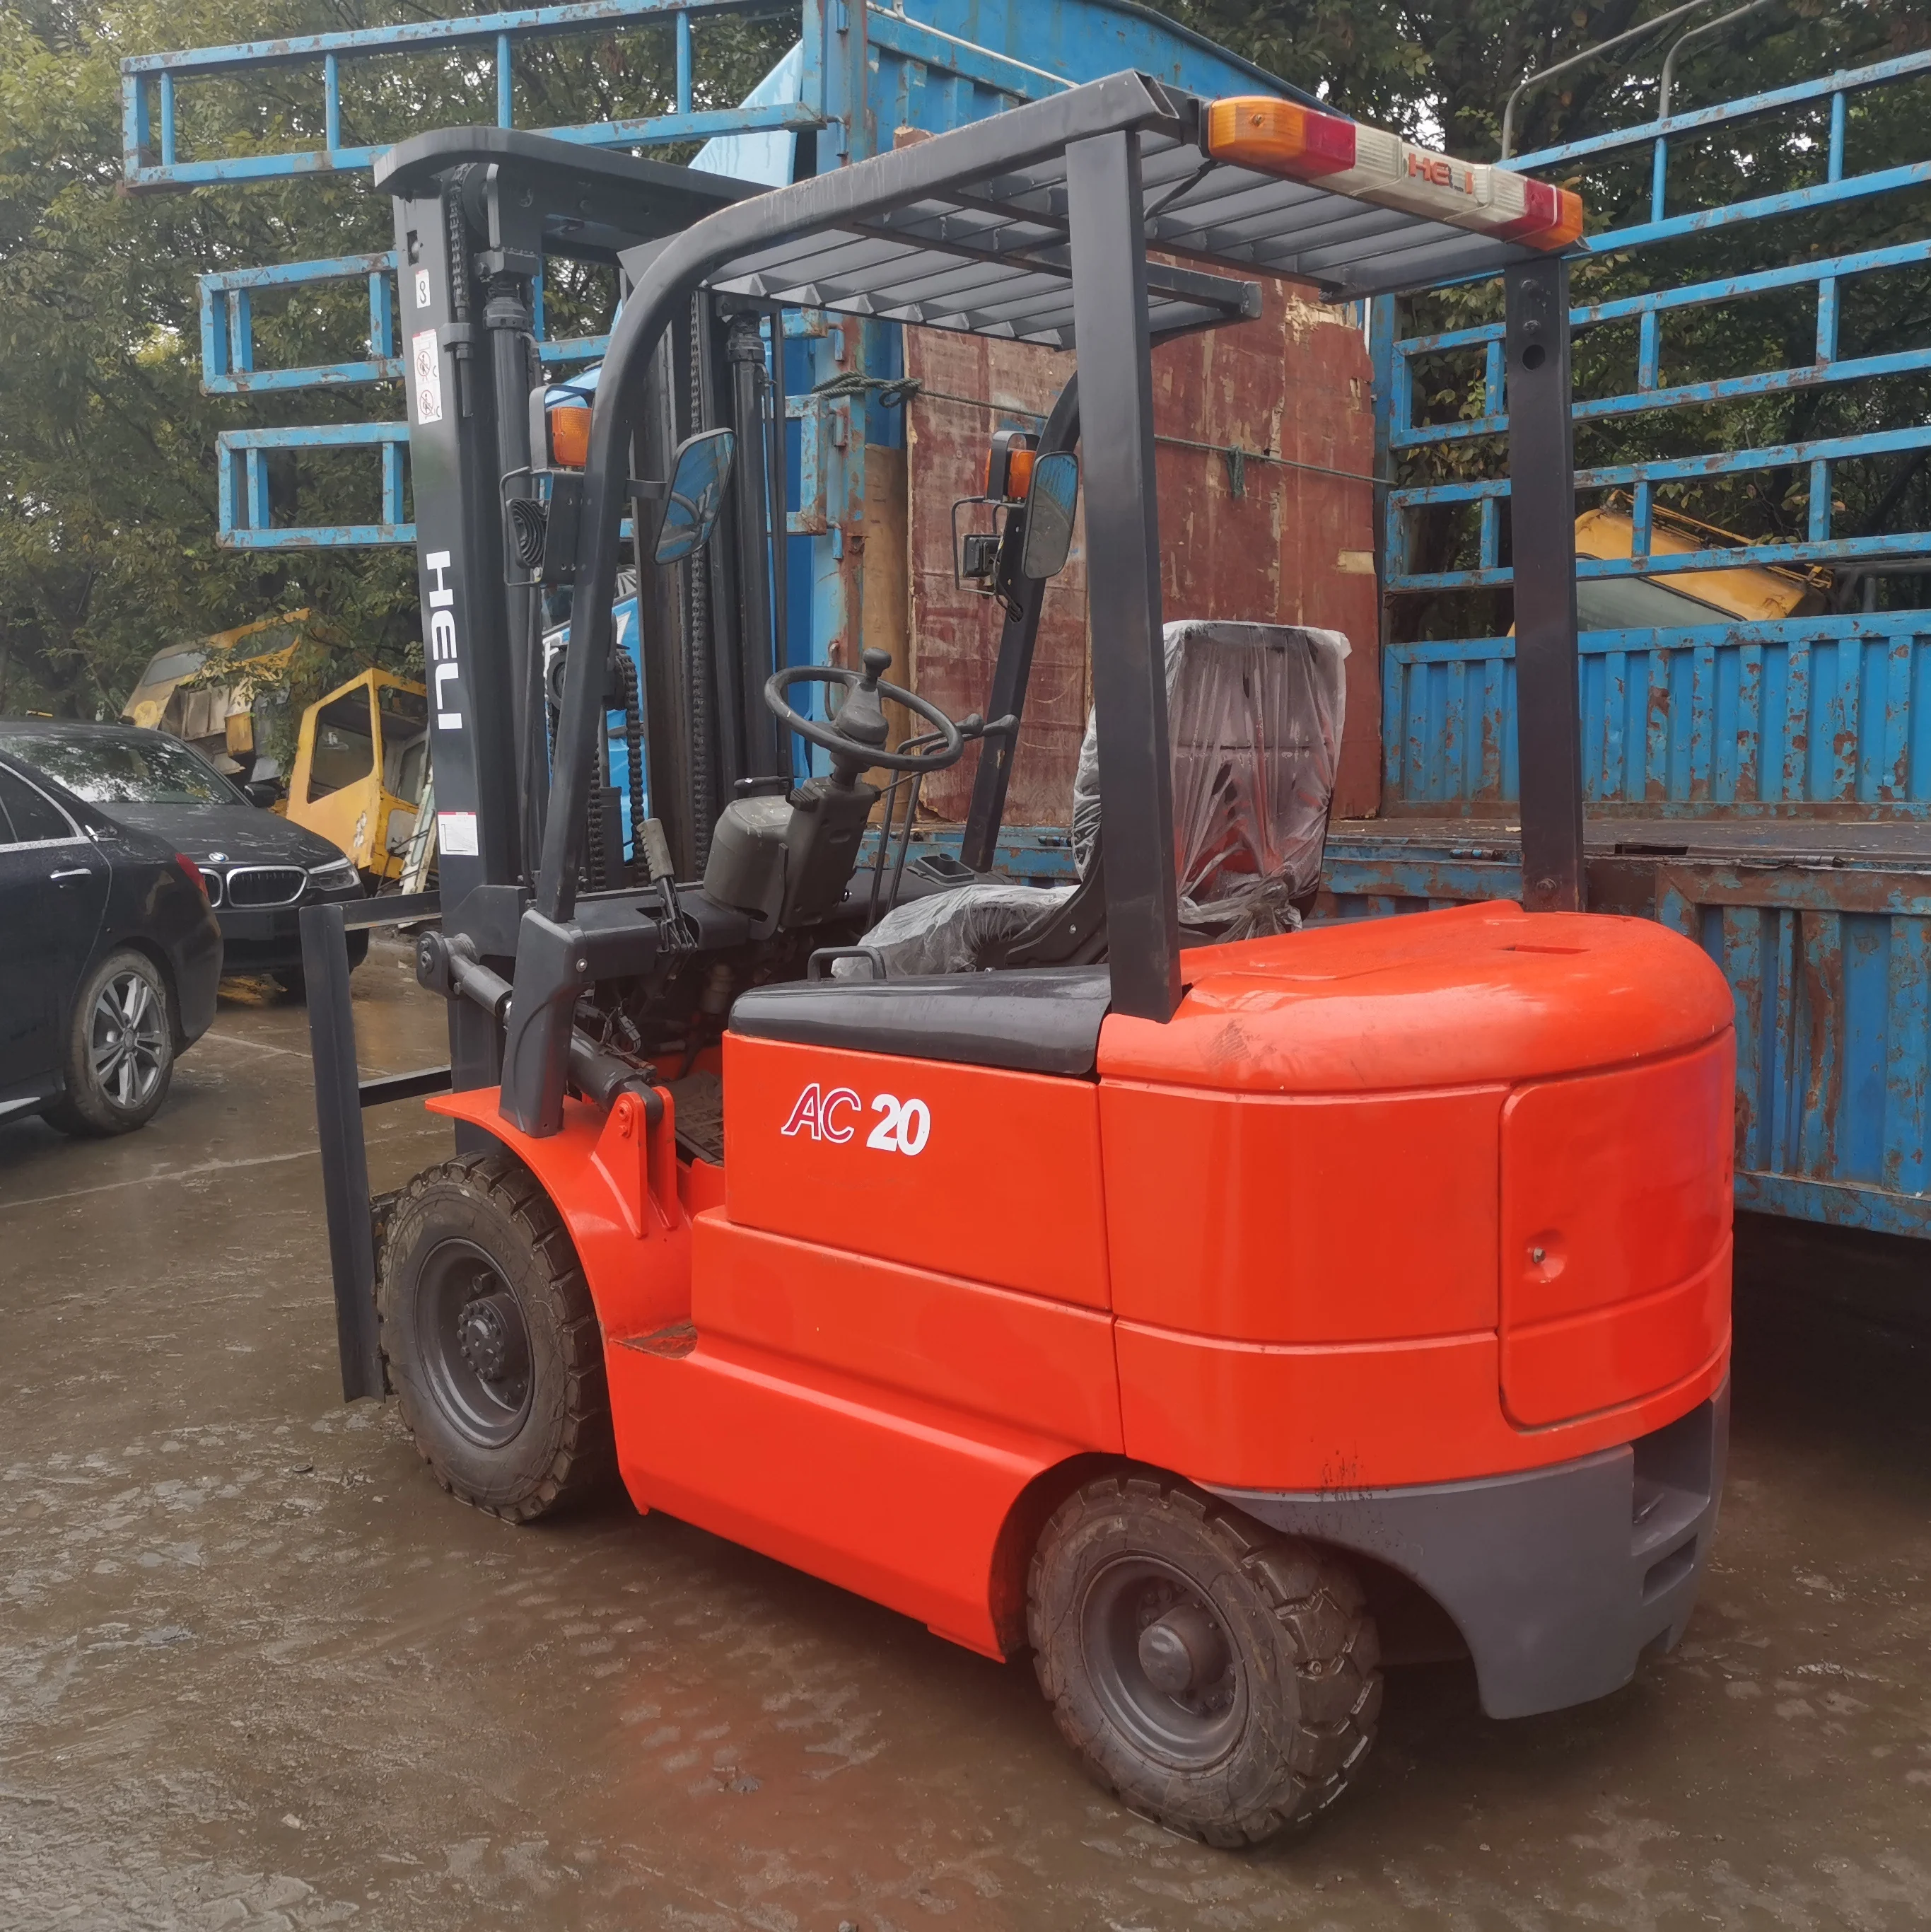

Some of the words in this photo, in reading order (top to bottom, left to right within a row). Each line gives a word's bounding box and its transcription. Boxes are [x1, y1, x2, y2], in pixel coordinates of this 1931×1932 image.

[426, 550, 462, 730] HELI
[781, 1083, 862, 1144] AC
[866, 1093, 931, 1156] 20
